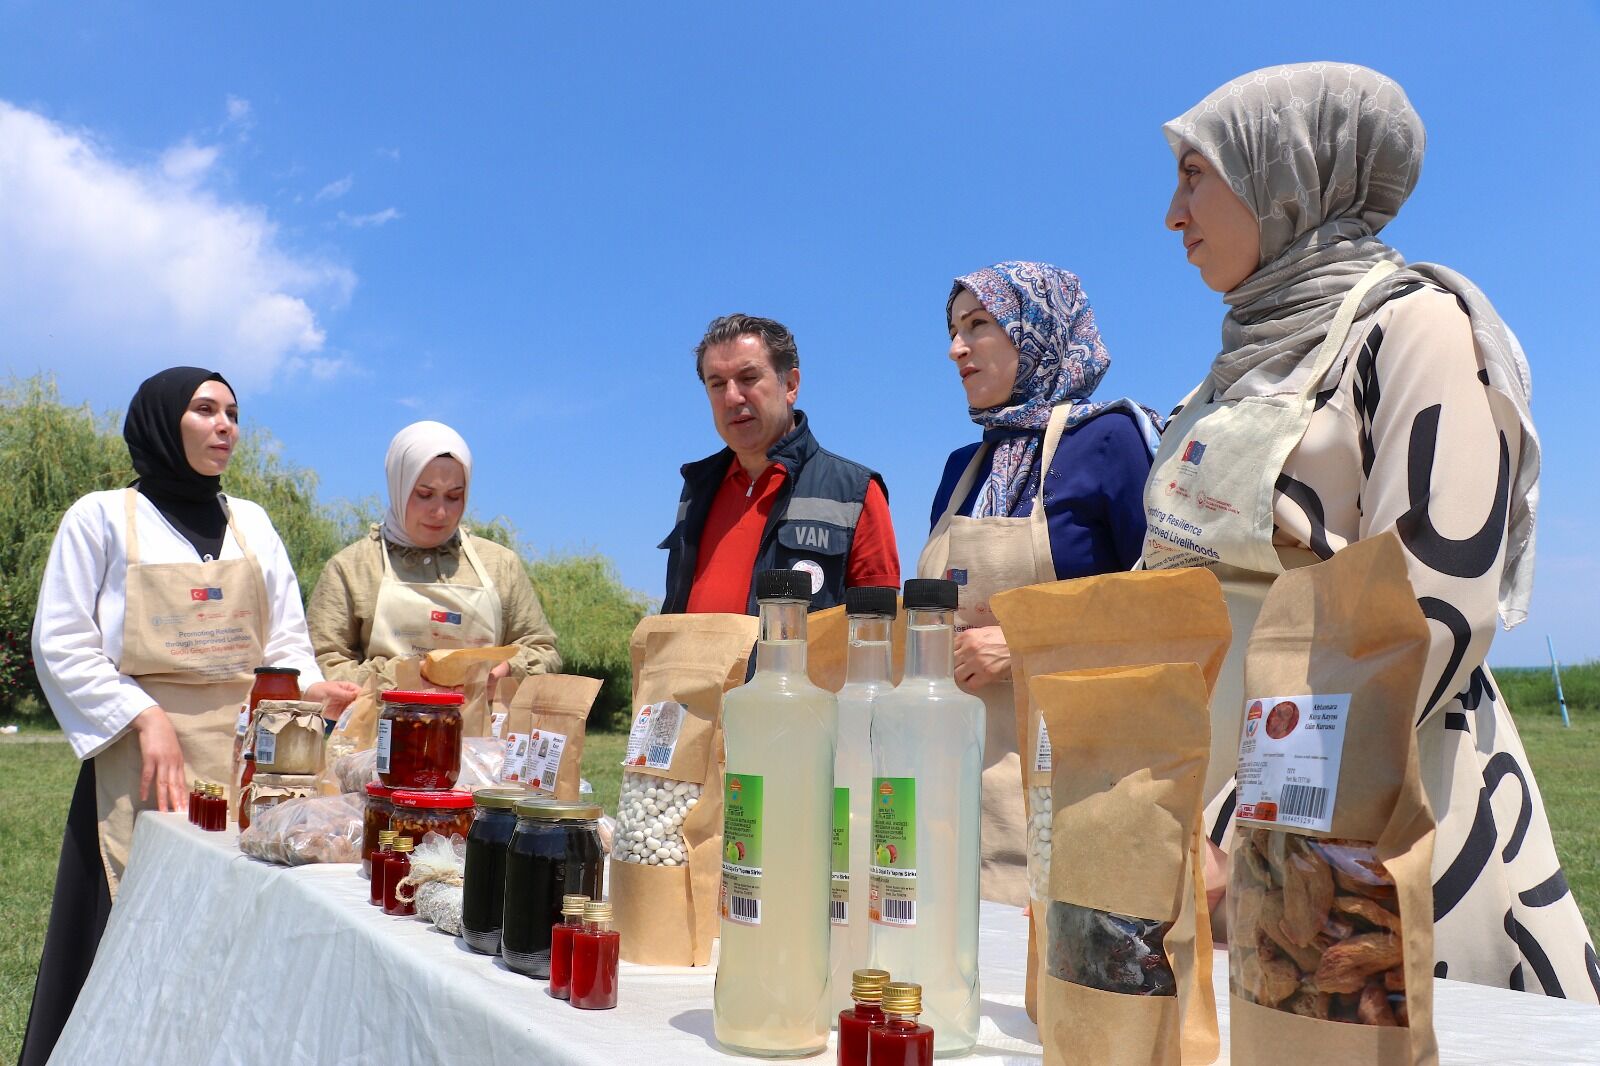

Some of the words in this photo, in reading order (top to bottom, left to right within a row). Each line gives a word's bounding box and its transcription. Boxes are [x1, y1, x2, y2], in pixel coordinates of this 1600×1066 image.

[1166, 513, 1202, 536] Resilience
[795, 526, 829, 549] VAN
[1169, 530, 1220, 560] Livelihoods
